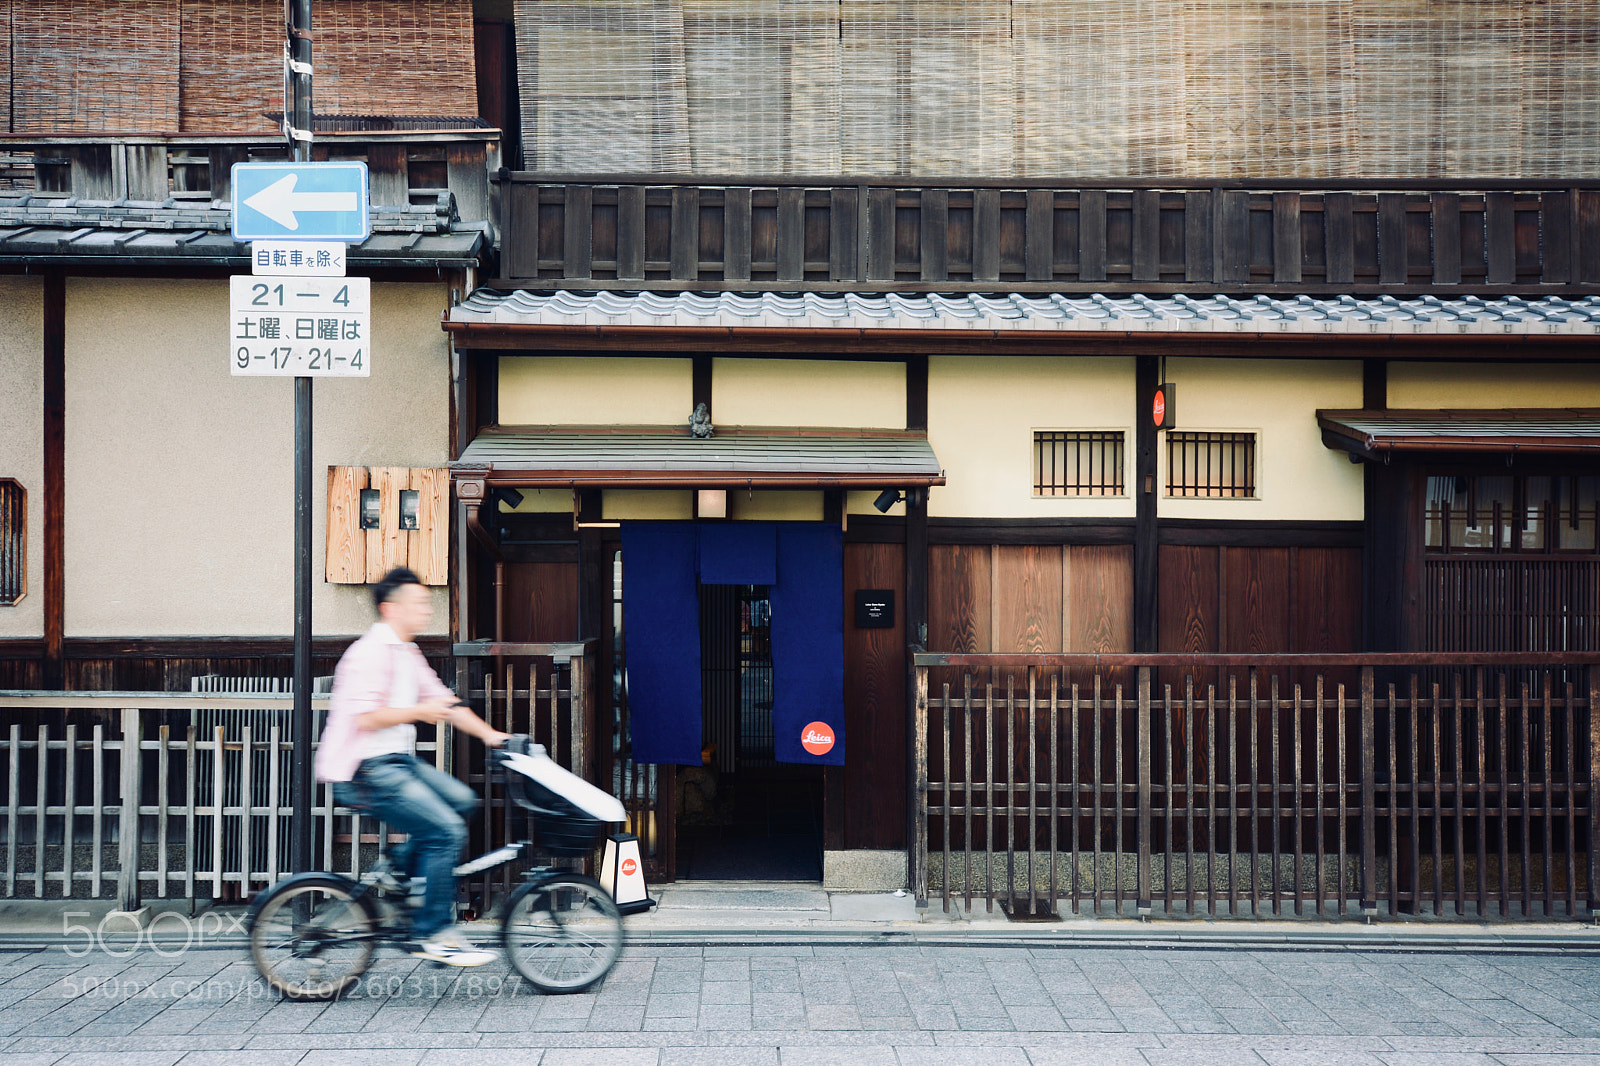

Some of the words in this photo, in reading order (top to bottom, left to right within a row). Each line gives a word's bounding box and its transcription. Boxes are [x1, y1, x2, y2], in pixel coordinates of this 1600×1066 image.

[257, 249, 341, 268] 自転車を除く
[236, 317, 361, 341] 土曜、日曜は
[802, 730, 832, 745] Leica
